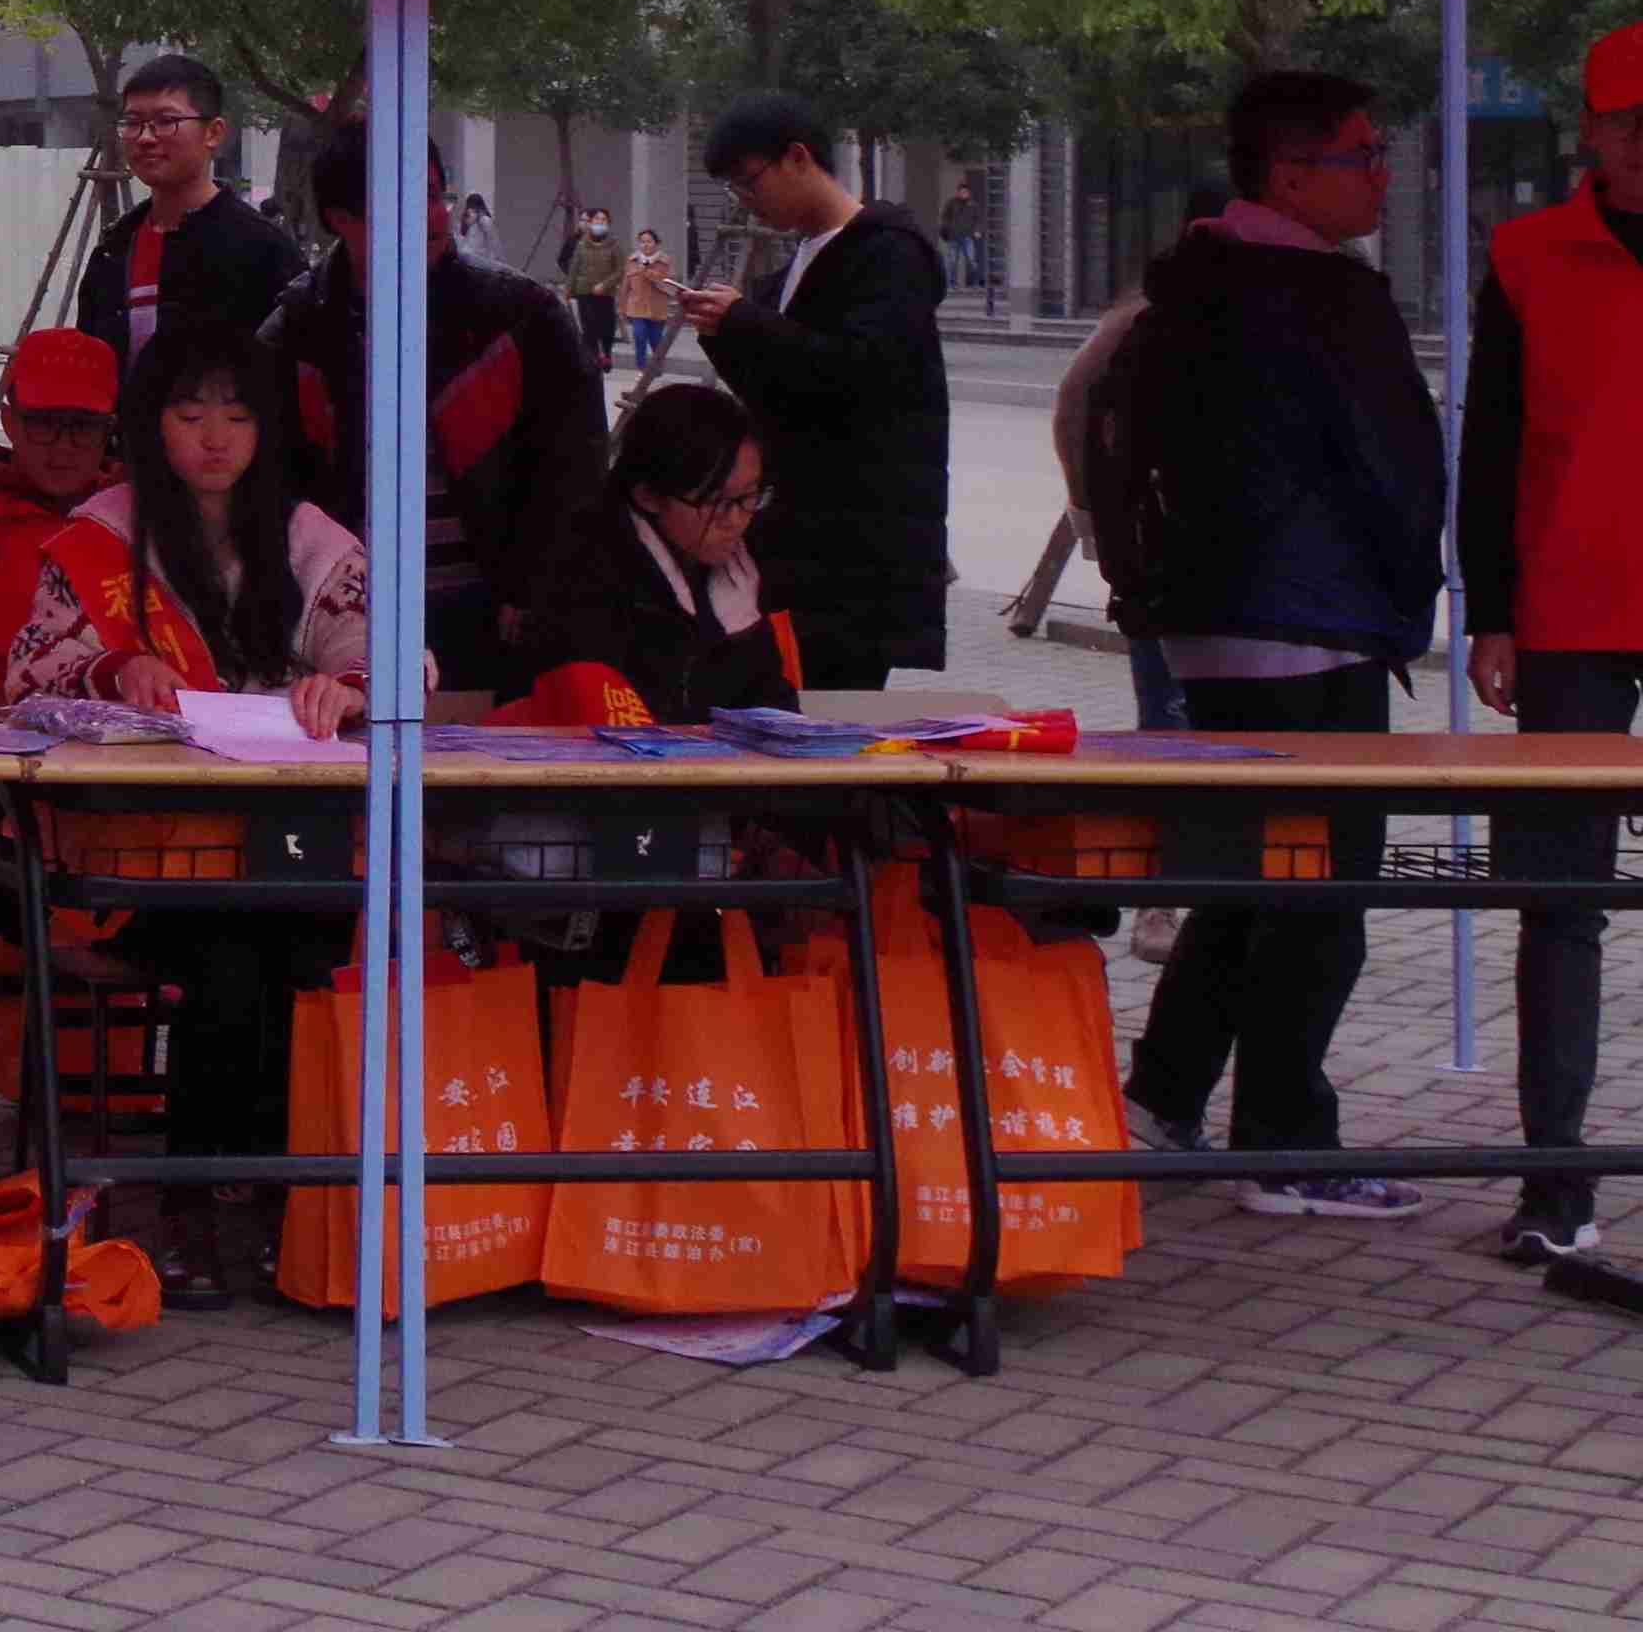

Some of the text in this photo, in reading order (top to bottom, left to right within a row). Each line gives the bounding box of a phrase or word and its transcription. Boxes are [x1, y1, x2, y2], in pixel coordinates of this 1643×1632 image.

[890, 1048, 1076, 1089] 创新会管理
[892, 1103, 1091, 1145] 维护谐稳定
